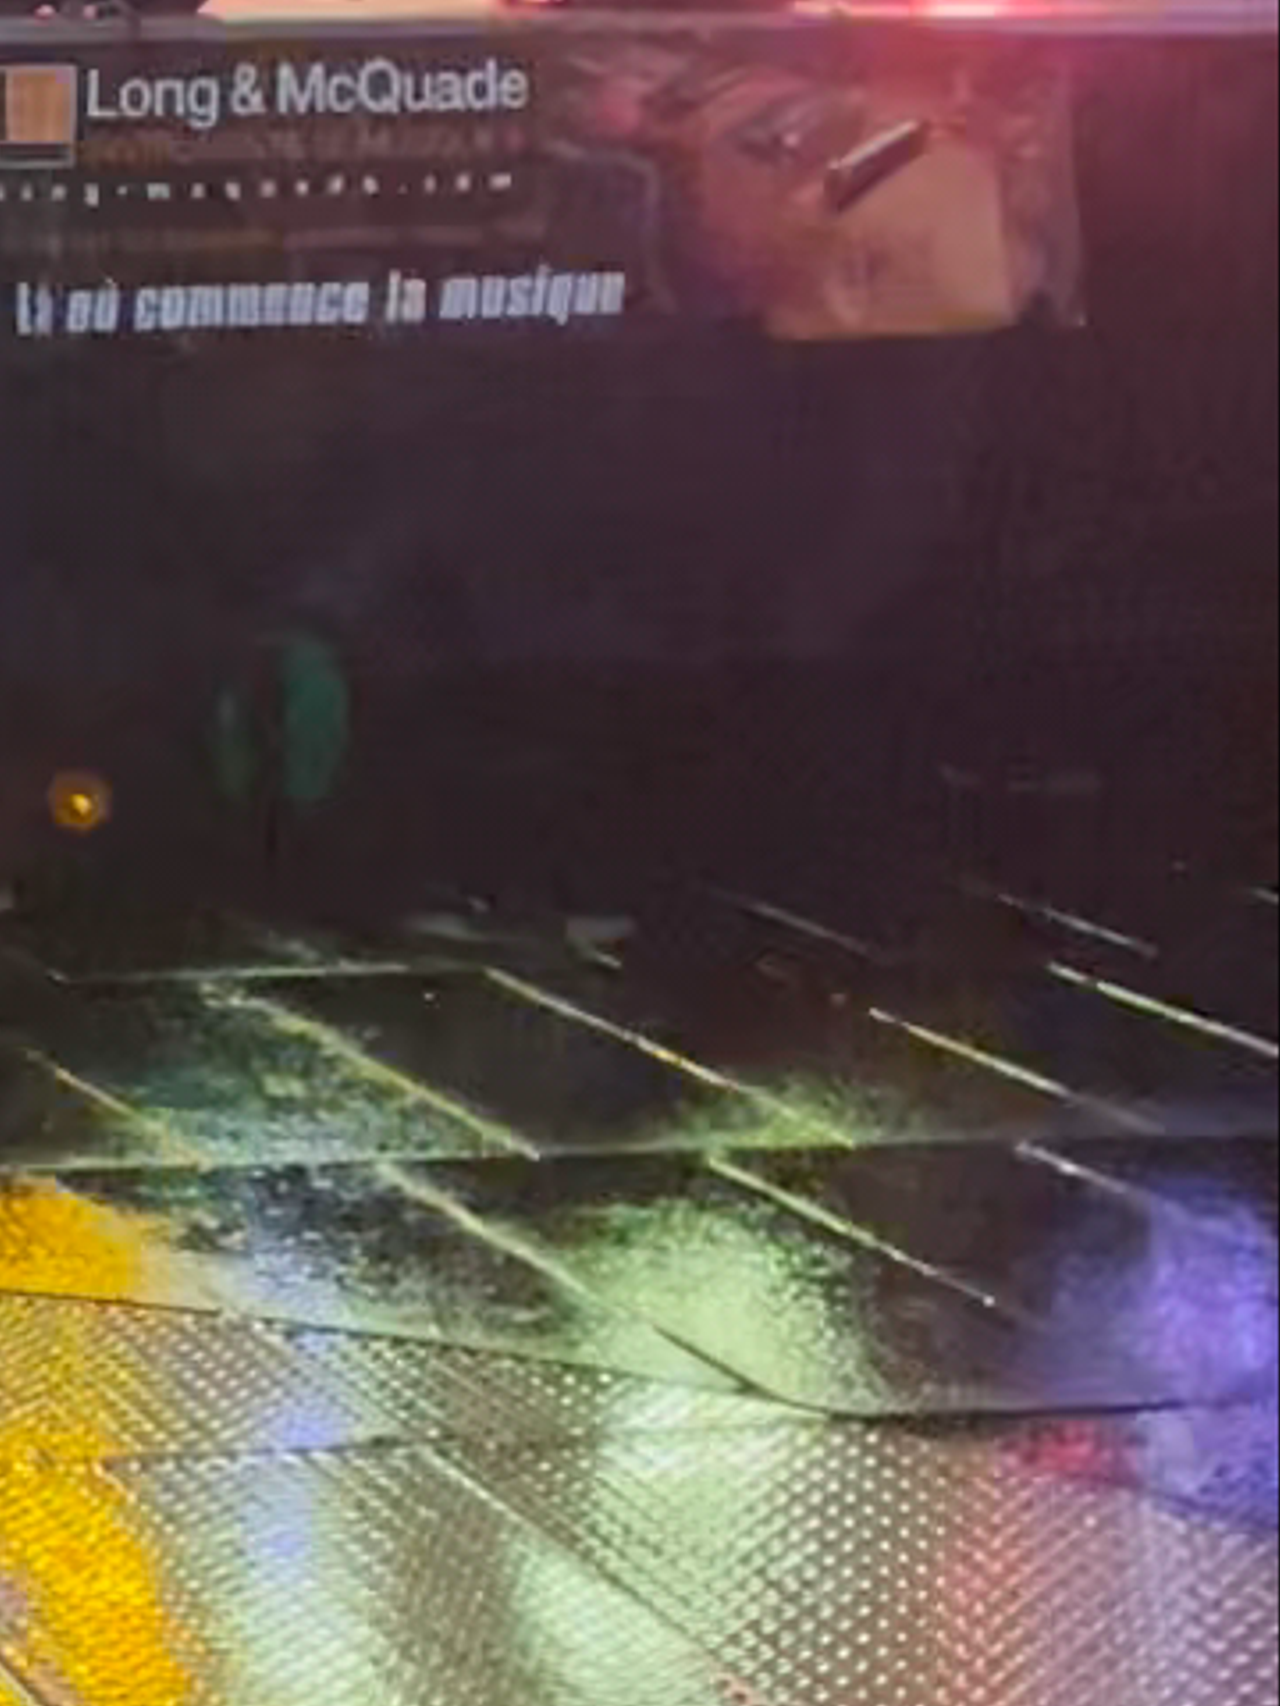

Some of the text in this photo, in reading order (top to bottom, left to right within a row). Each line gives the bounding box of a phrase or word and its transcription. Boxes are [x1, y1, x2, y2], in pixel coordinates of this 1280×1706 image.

[86, 59, 529, 129] Long & McQuade
